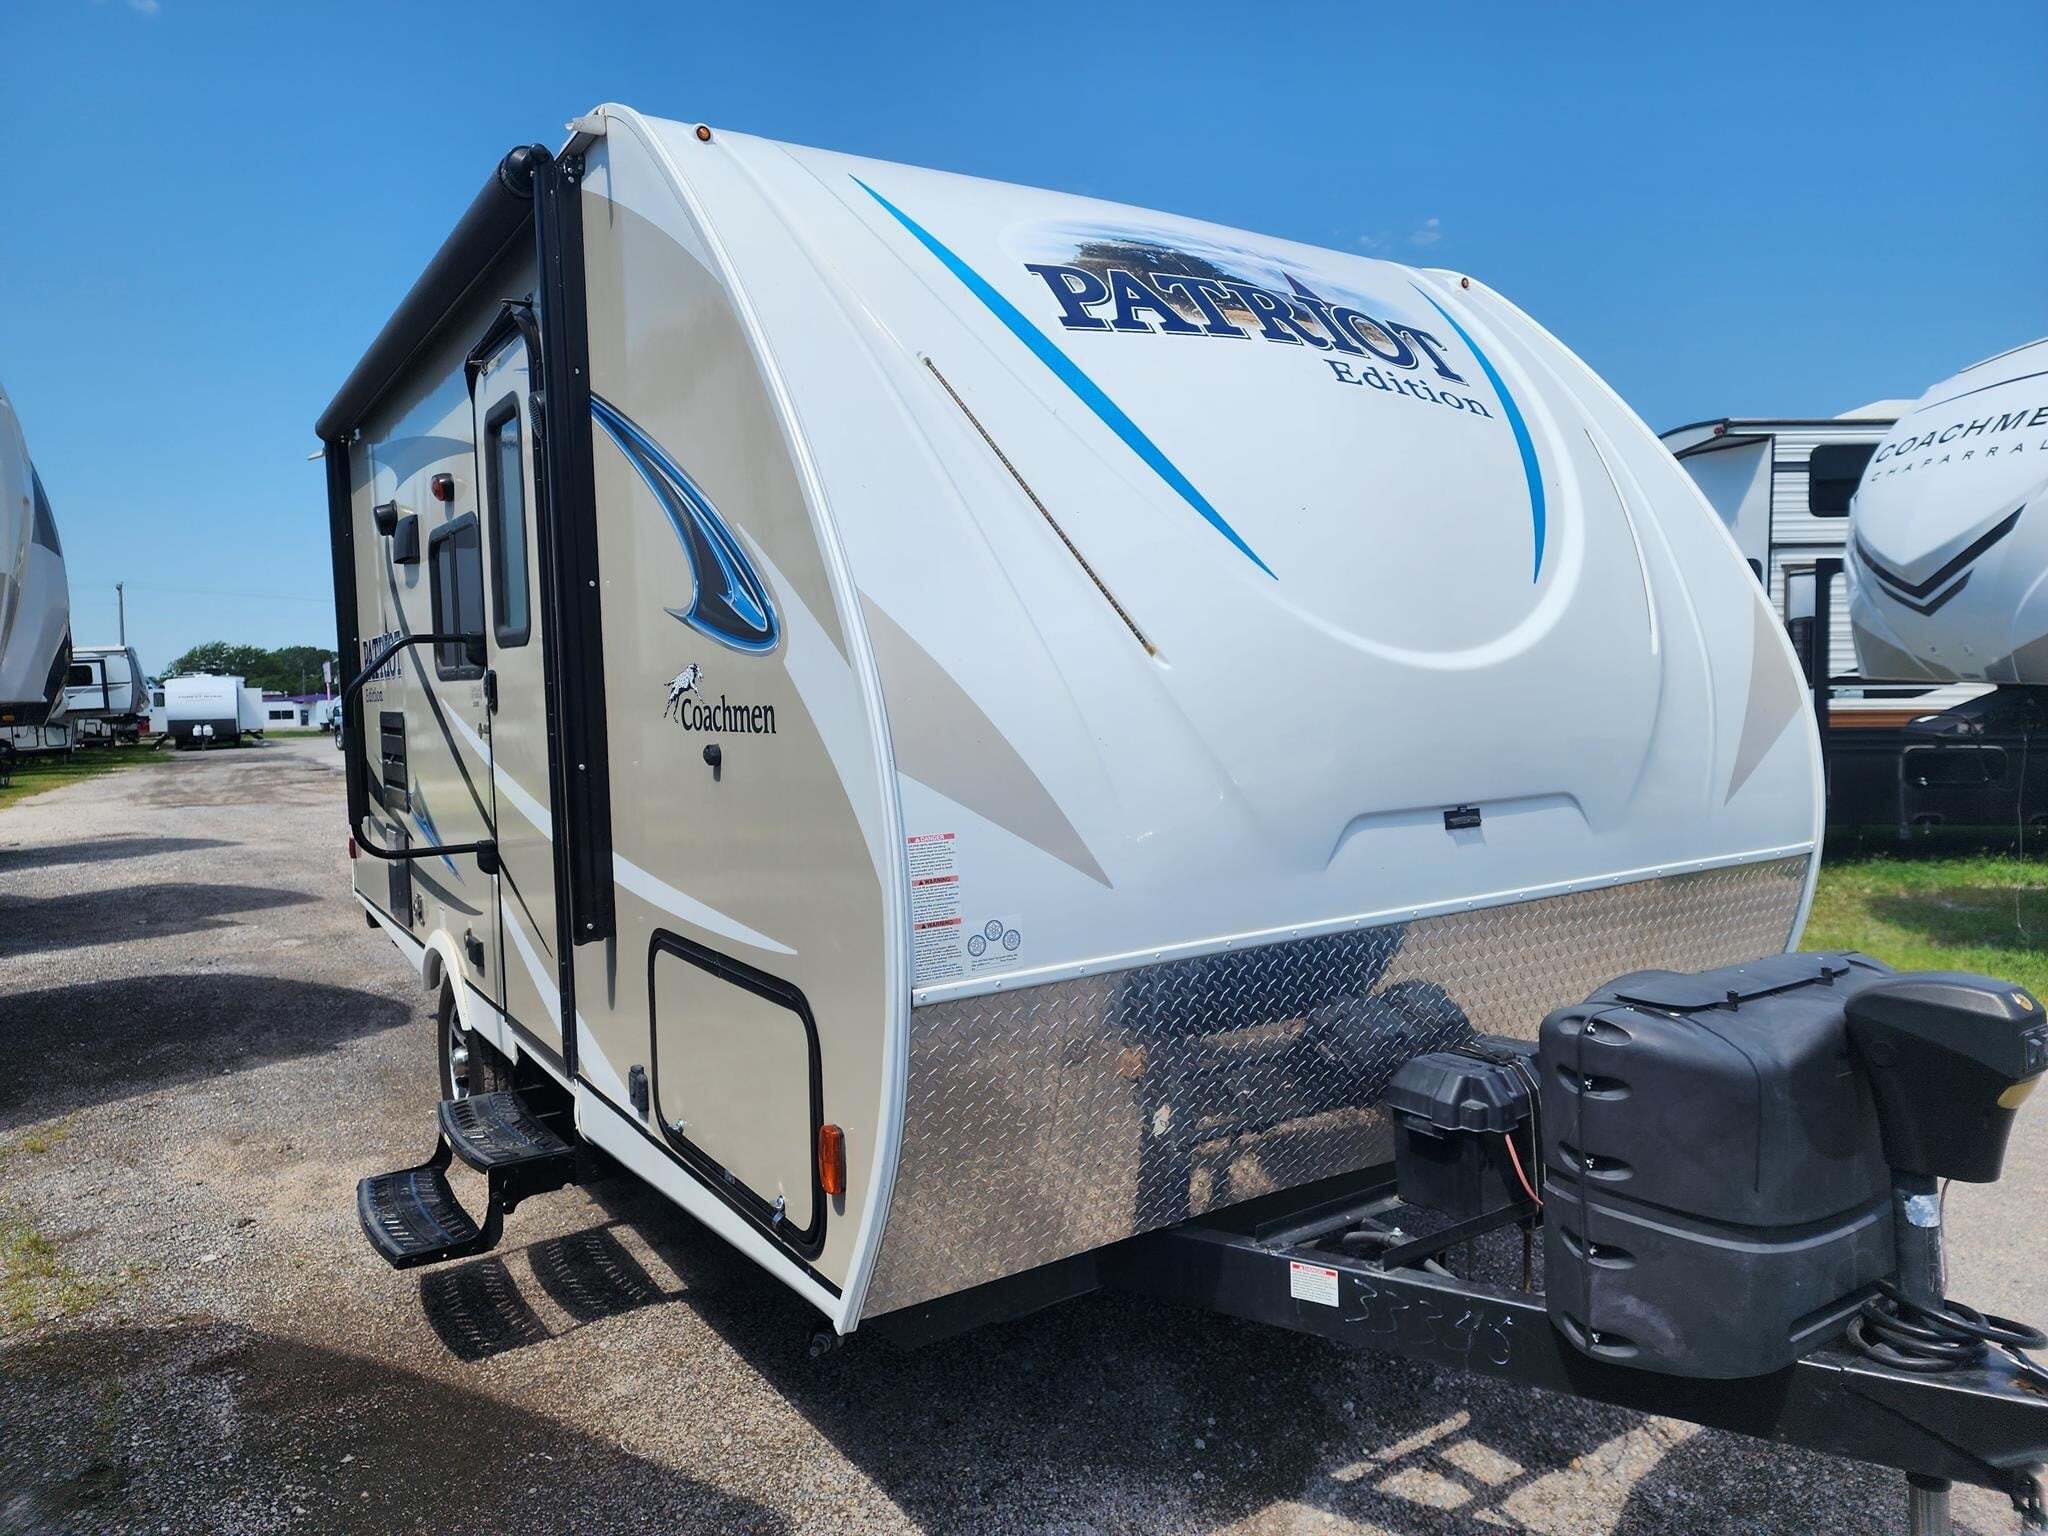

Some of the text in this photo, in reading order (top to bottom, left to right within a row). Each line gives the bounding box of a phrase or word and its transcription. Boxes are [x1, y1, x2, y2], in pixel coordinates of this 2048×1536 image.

[1024, 263, 1471, 386] PATRIOT
[1324, 358, 1494, 419] Edition
[681, 695, 777, 734] Coachmen
[920, 834, 945, 842] DANGER
[925, 876, 951, 884] WARNING
[927, 919, 954, 928] WARNING
